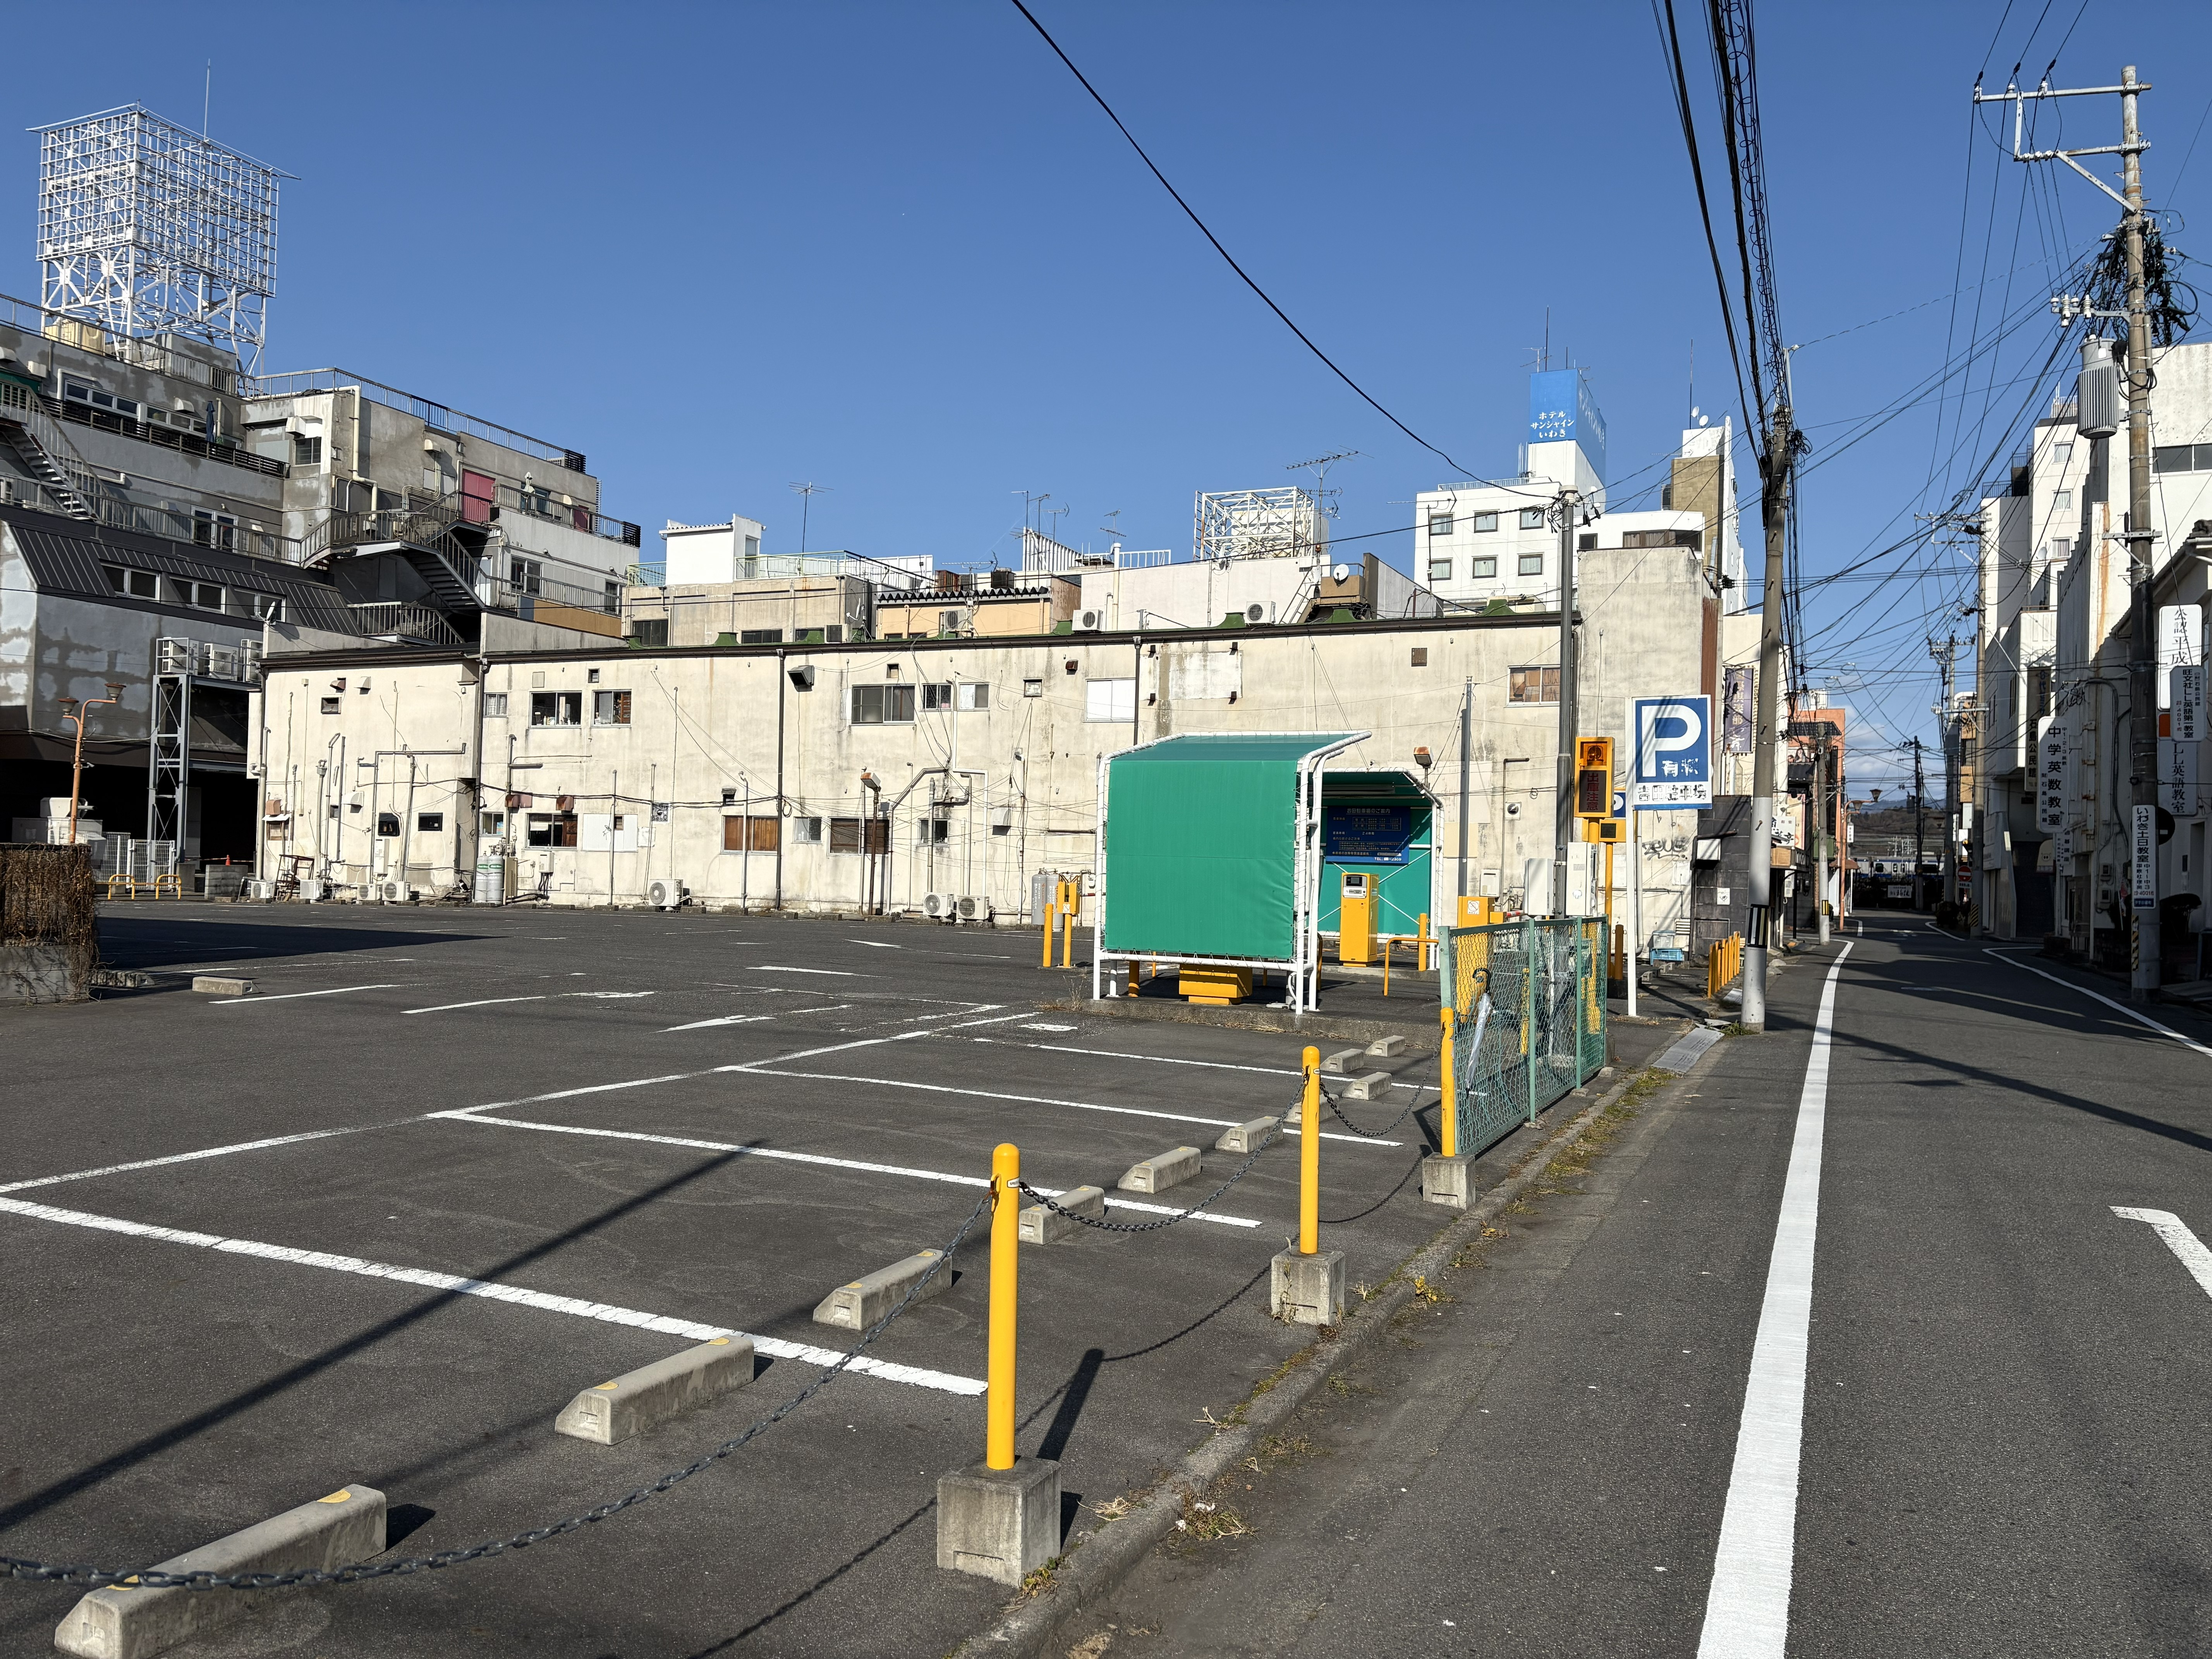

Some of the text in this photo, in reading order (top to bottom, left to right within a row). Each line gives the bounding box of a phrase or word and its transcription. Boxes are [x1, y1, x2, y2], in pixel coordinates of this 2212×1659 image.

[1530, 419, 1575, 430] サンシャイン
[1539, 410, 1566, 420] ホテル
[1539, 429, 1566, 438] いわき
[1642, 704, 1701, 777] P
[2028, 719, 2037, 778] 石島公民館
[1587, 772, 1599, 811] 出庫注意
[2048, 726, 2062, 826] 中学英数教室
[2136, 807, 2149, 862] いわき土日教室
